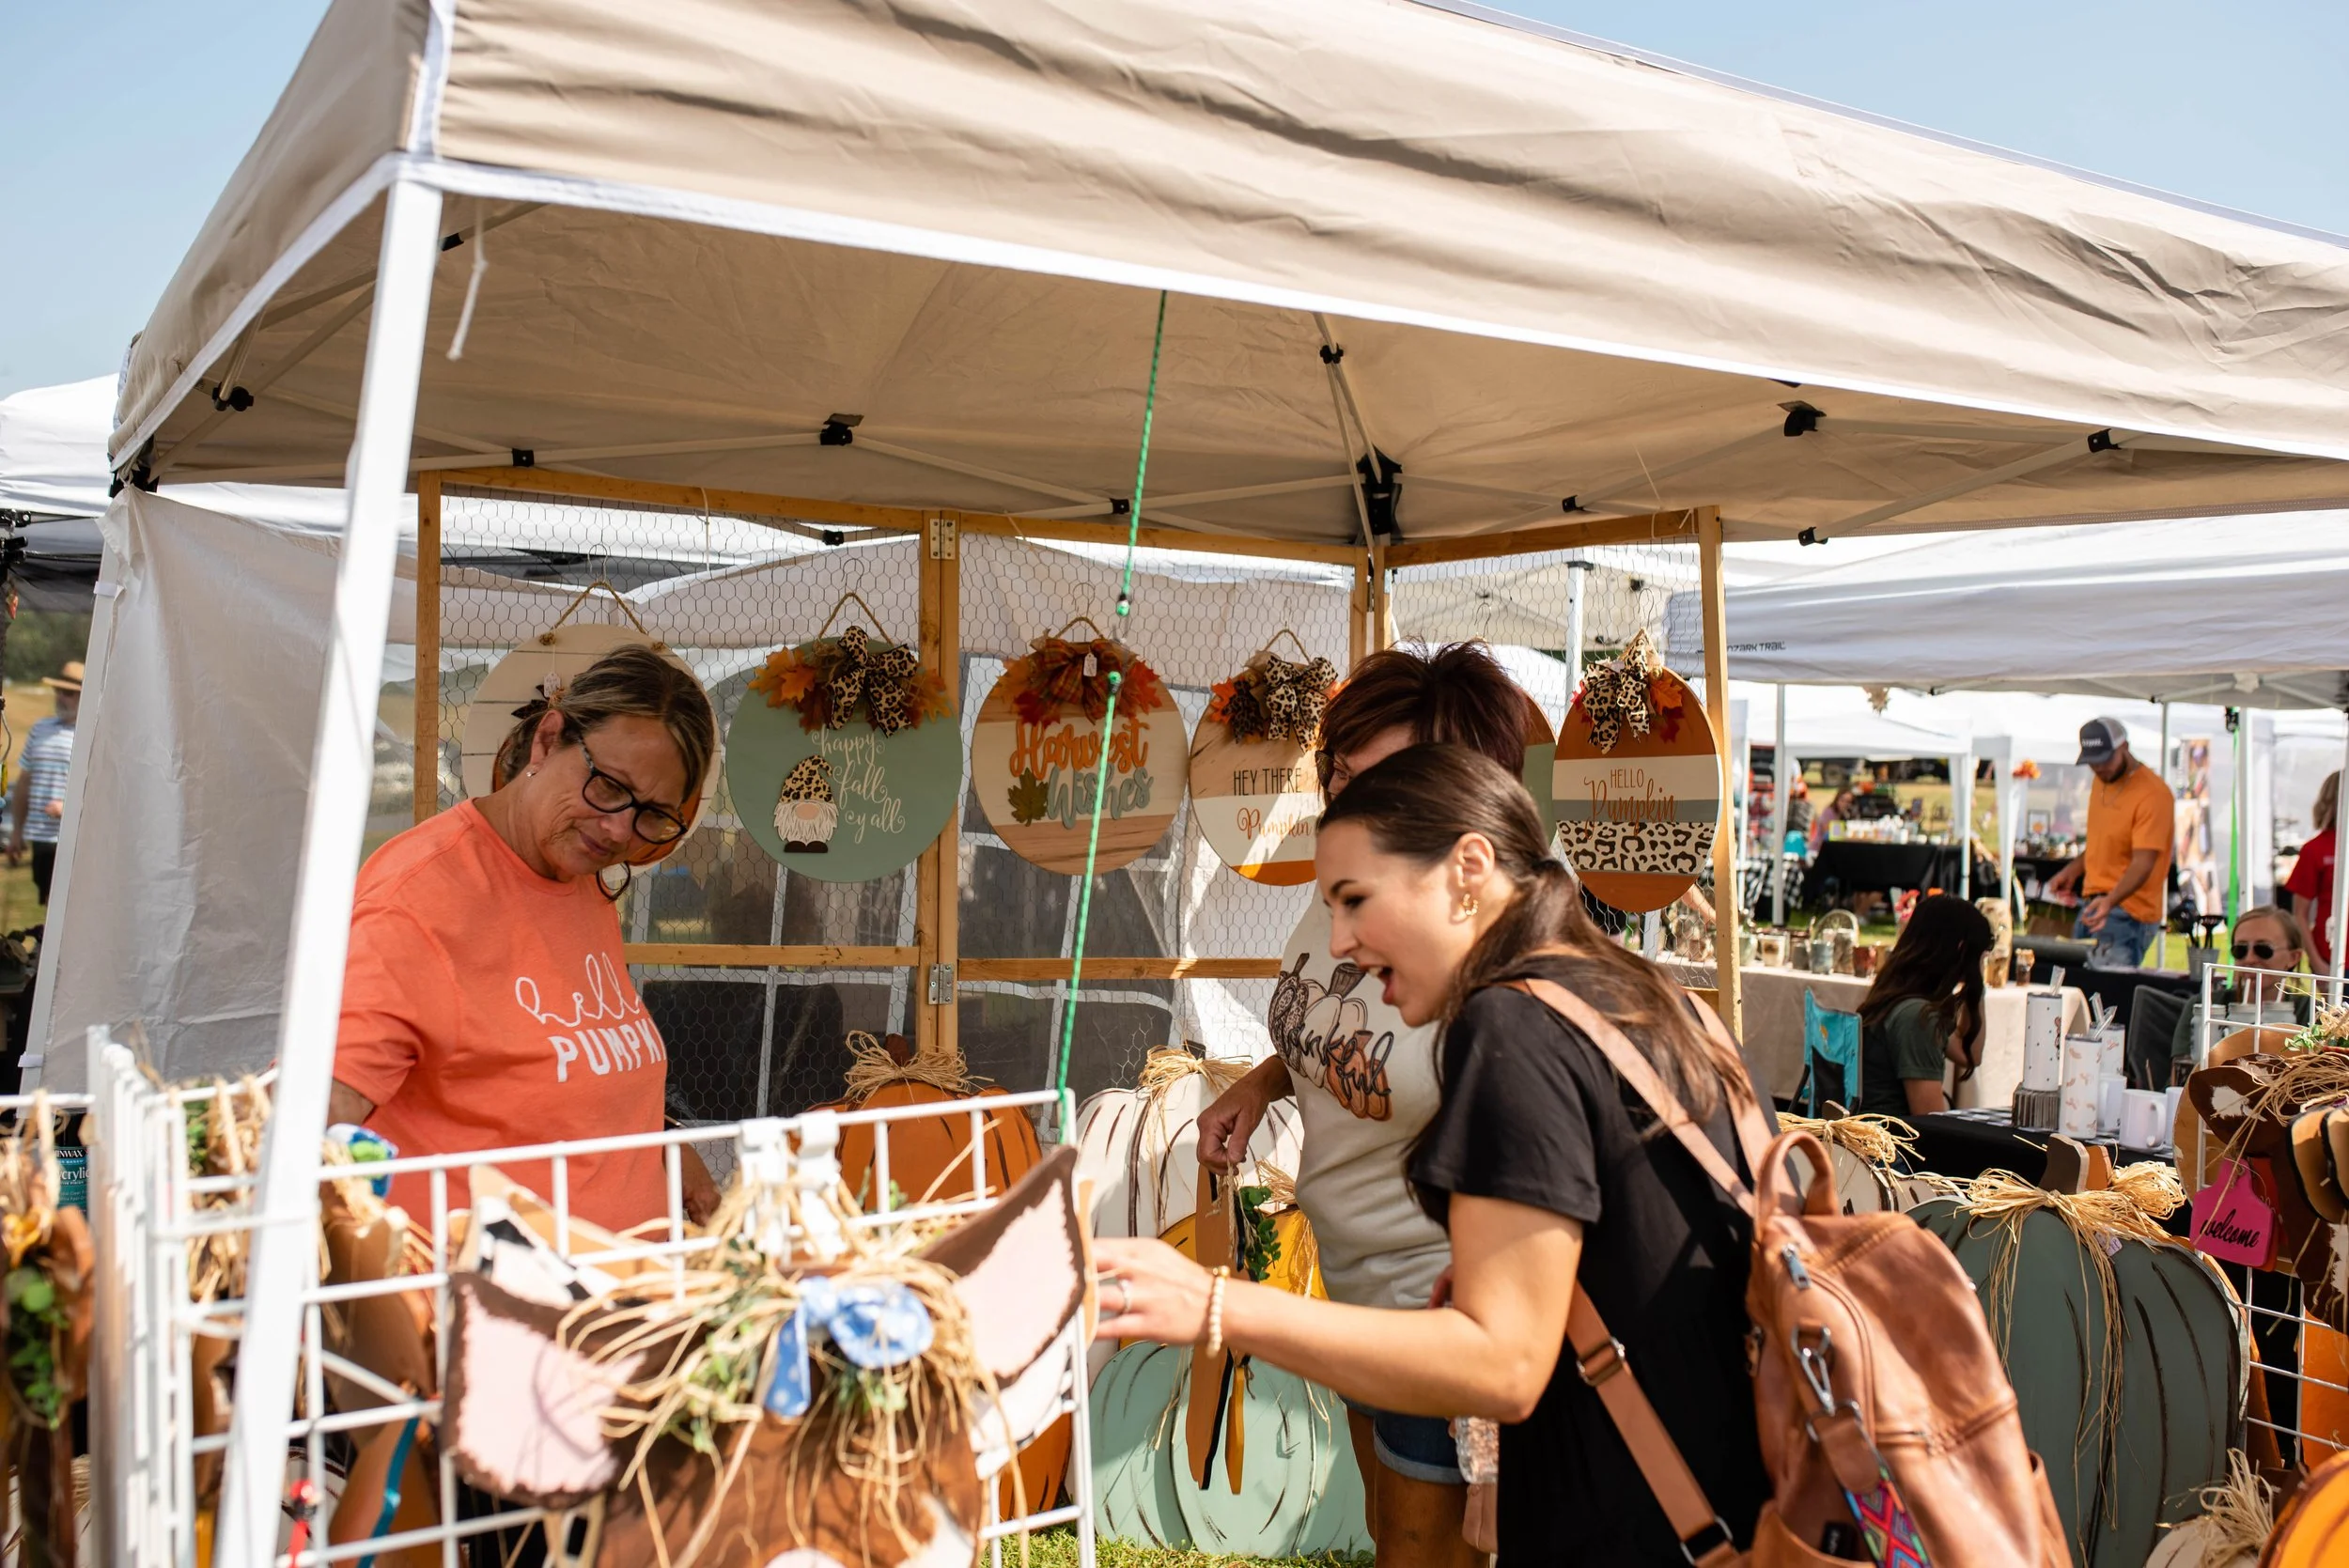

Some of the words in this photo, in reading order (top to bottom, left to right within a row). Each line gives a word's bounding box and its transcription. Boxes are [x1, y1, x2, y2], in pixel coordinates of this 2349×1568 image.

[811, 723, 885, 765] happy
[1010, 716, 1150, 780] Harvest
[832, 759, 888, 810] fall
[1047, 763, 1154, 830] Wishes
[1233, 768, 1258, 797] HEY
[1262, 767, 1302, 795] THERE
[1610, 768, 1644, 789] HELLO
[1237, 807, 1314, 844] Pumpkin
[1583, 776, 1677, 841] Pumpkin
[54, 1149, 83, 1157] INWAX
[2199, 1208, 2261, 1249] welcome
